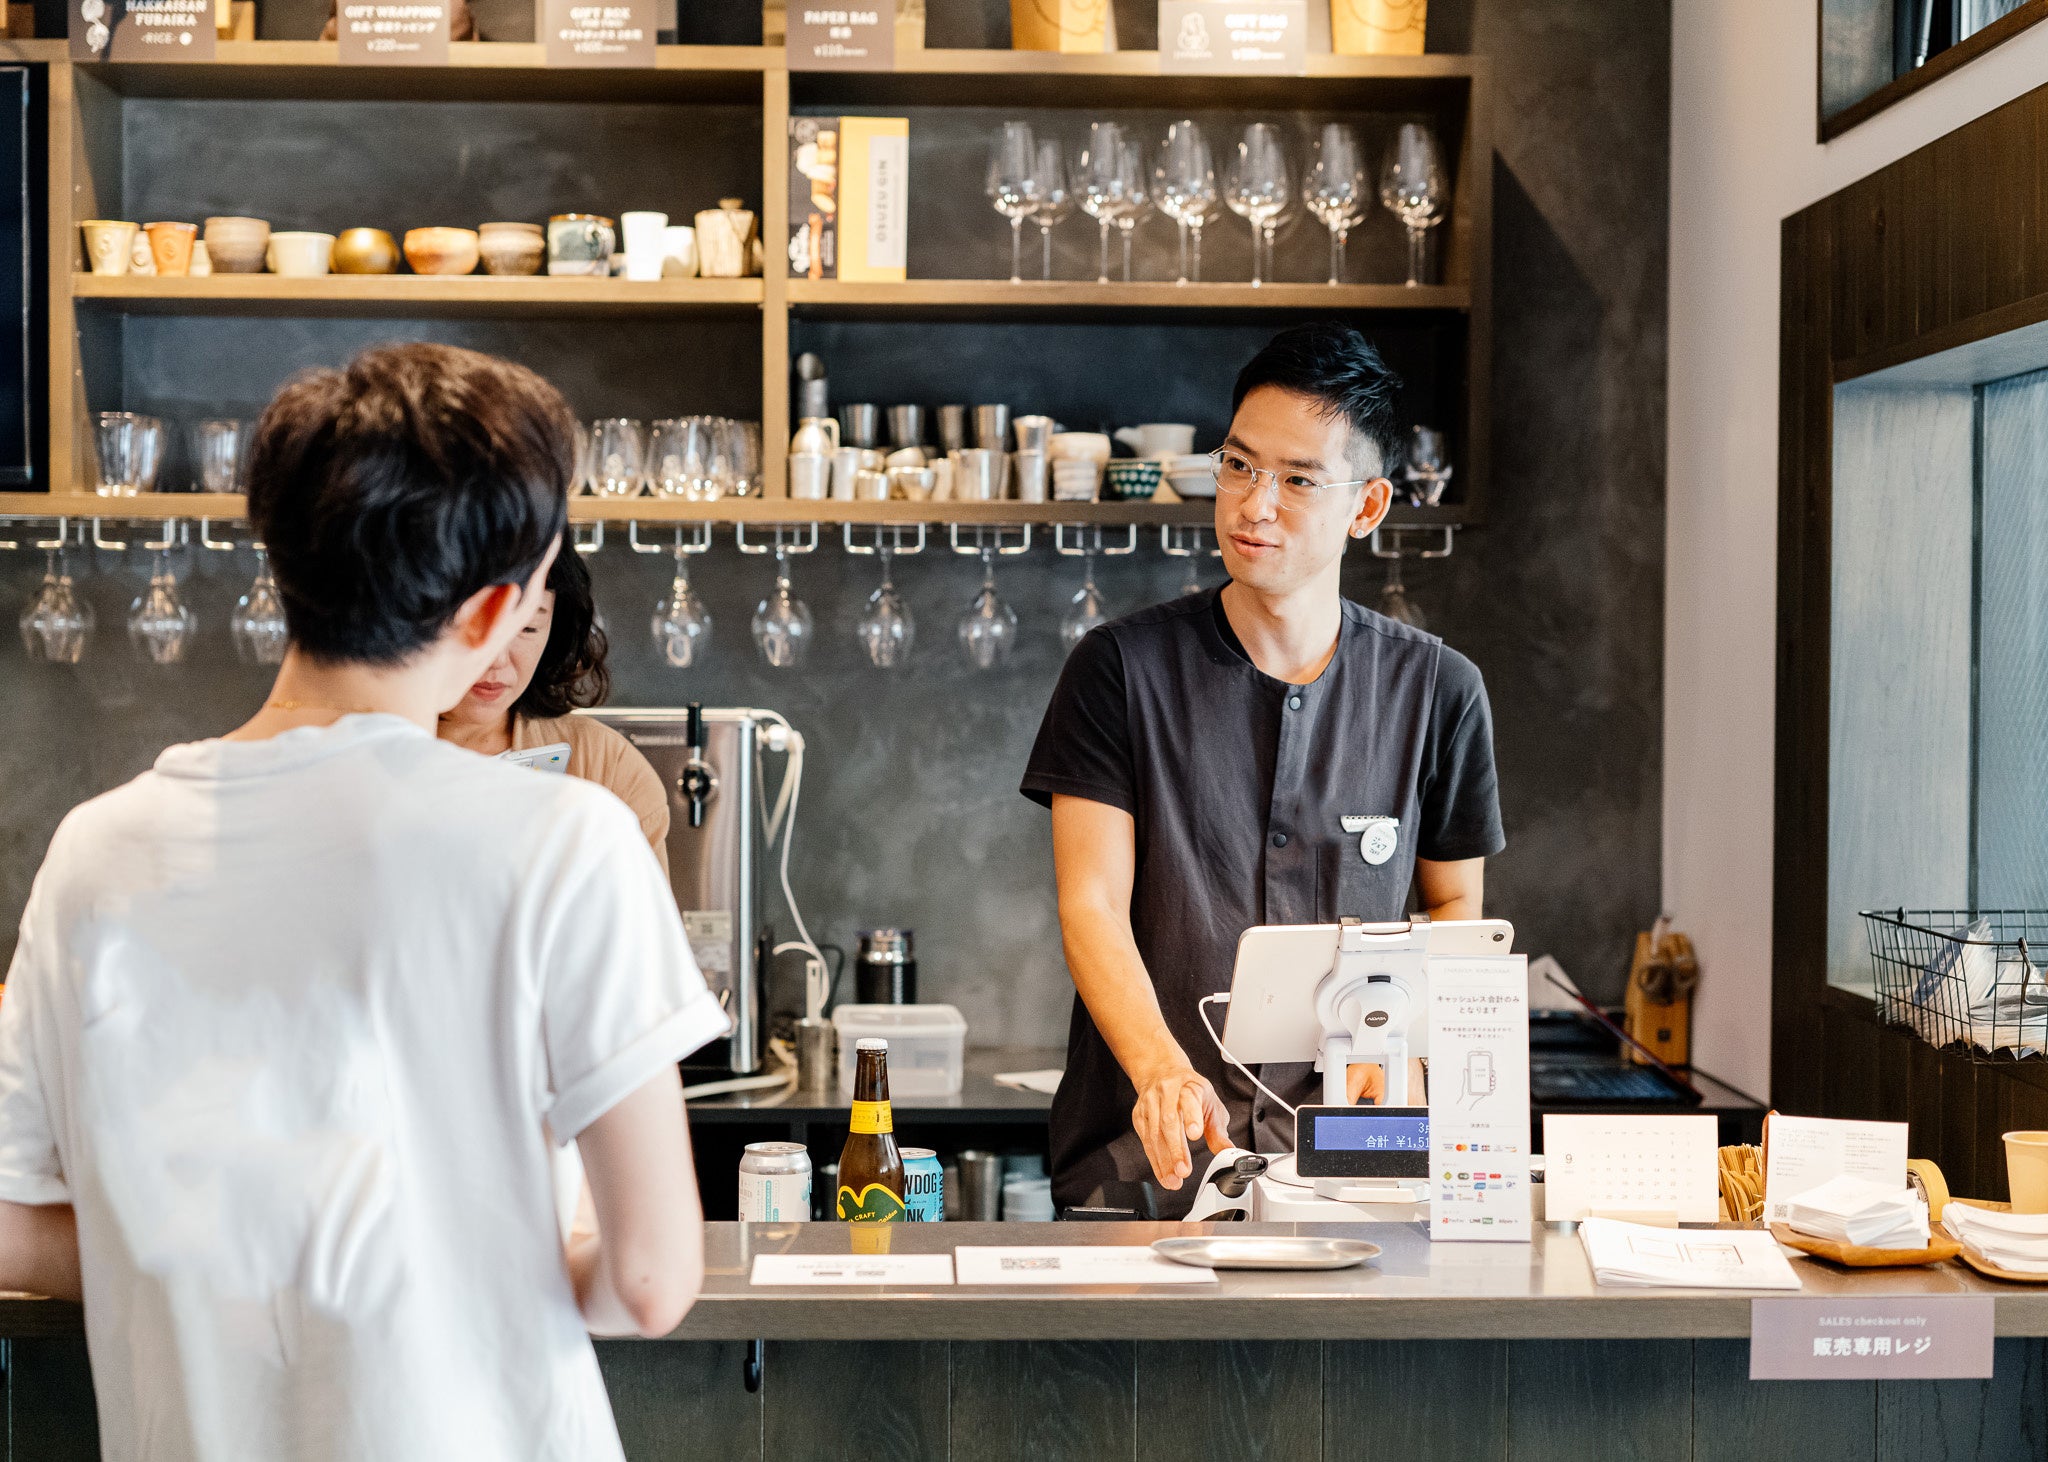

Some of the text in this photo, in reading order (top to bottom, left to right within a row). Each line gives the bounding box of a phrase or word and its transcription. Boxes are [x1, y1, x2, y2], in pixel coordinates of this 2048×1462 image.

[803, 11, 879, 25] PAPER BAG
[1437, 995, 1520, 1004] キャッシュレス会計のみ
[1459, 1006, 1498, 1014] となります
[1364, 1135, 1389, 1149] 合計
[1565, 1153, 1574, 1164] 9
[854, 1211, 876, 1221] CRAFT
[1818, 1316, 1928, 1328] SALES checkout only
[1813, 1336, 1932, 1357] 販売専用レジ
